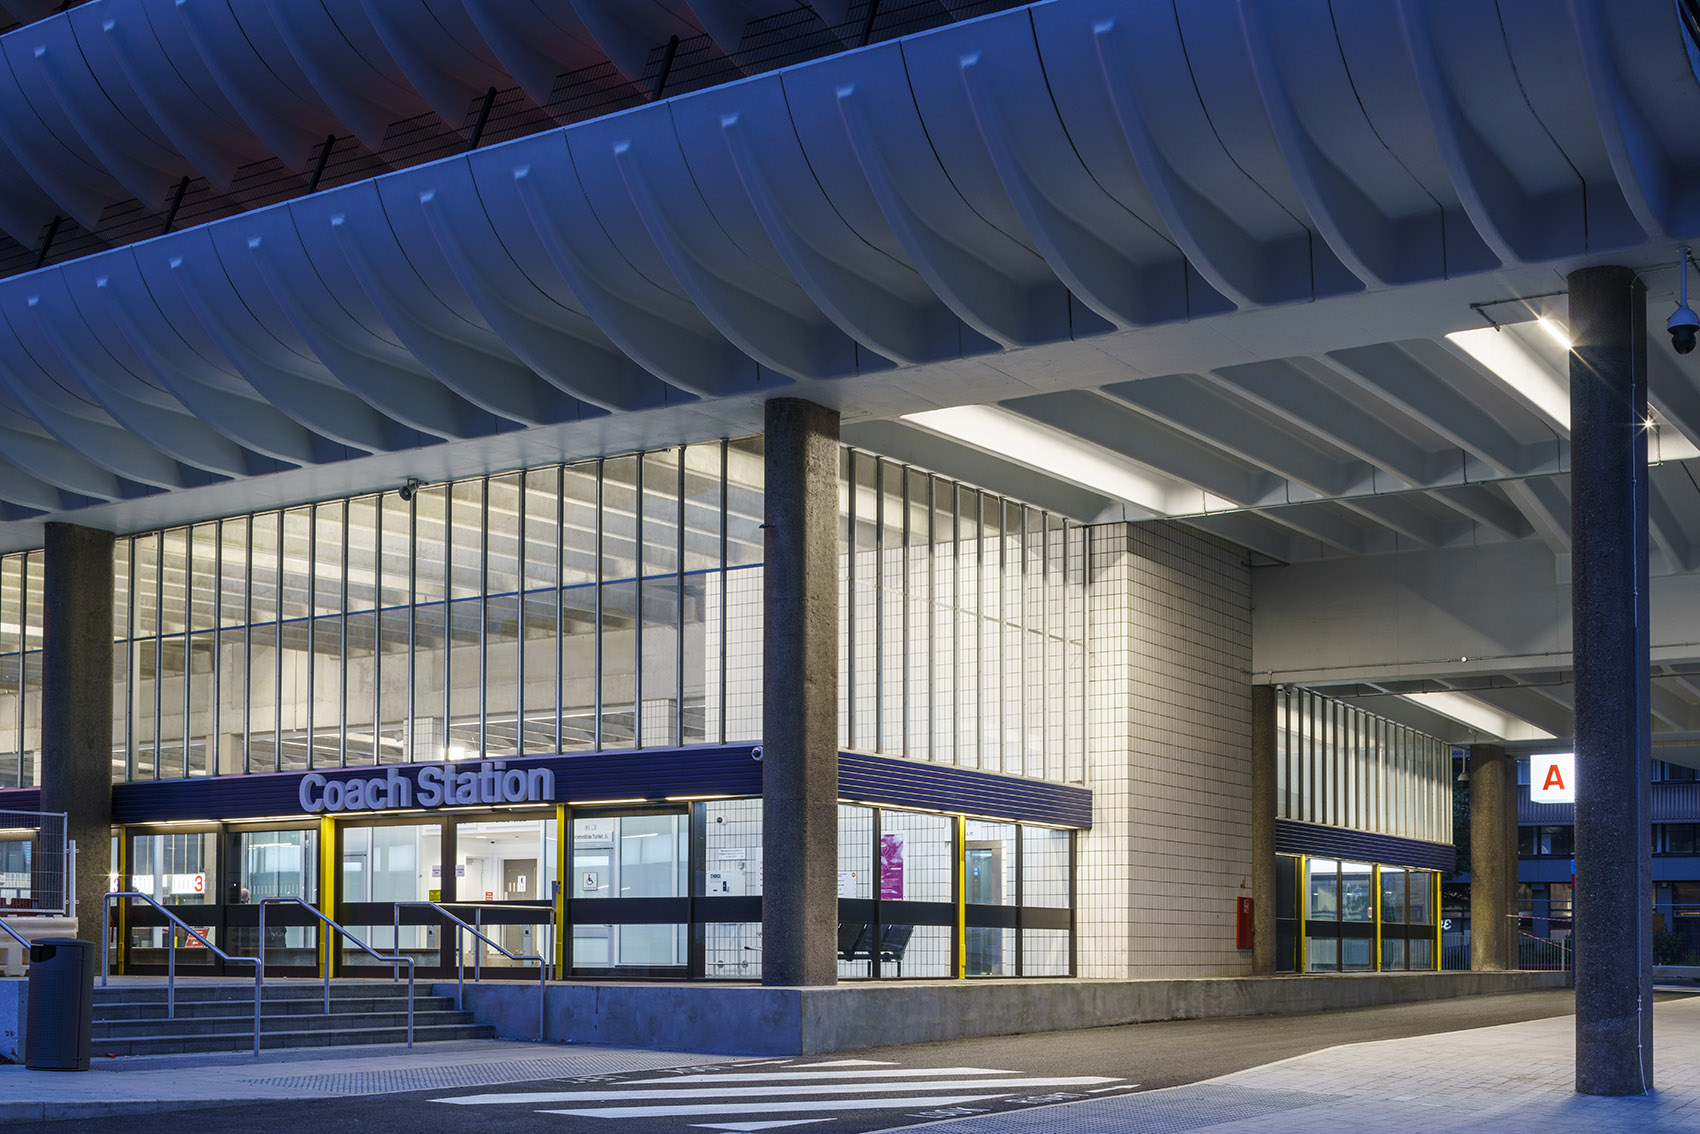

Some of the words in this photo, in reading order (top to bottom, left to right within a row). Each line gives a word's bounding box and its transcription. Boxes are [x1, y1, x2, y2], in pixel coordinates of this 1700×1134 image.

[299, 767, 412, 813] Coach
[417, 761, 555, 807] Station
[1542, 764, 1566, 791] A
[194, 875, 203, 892] 3
